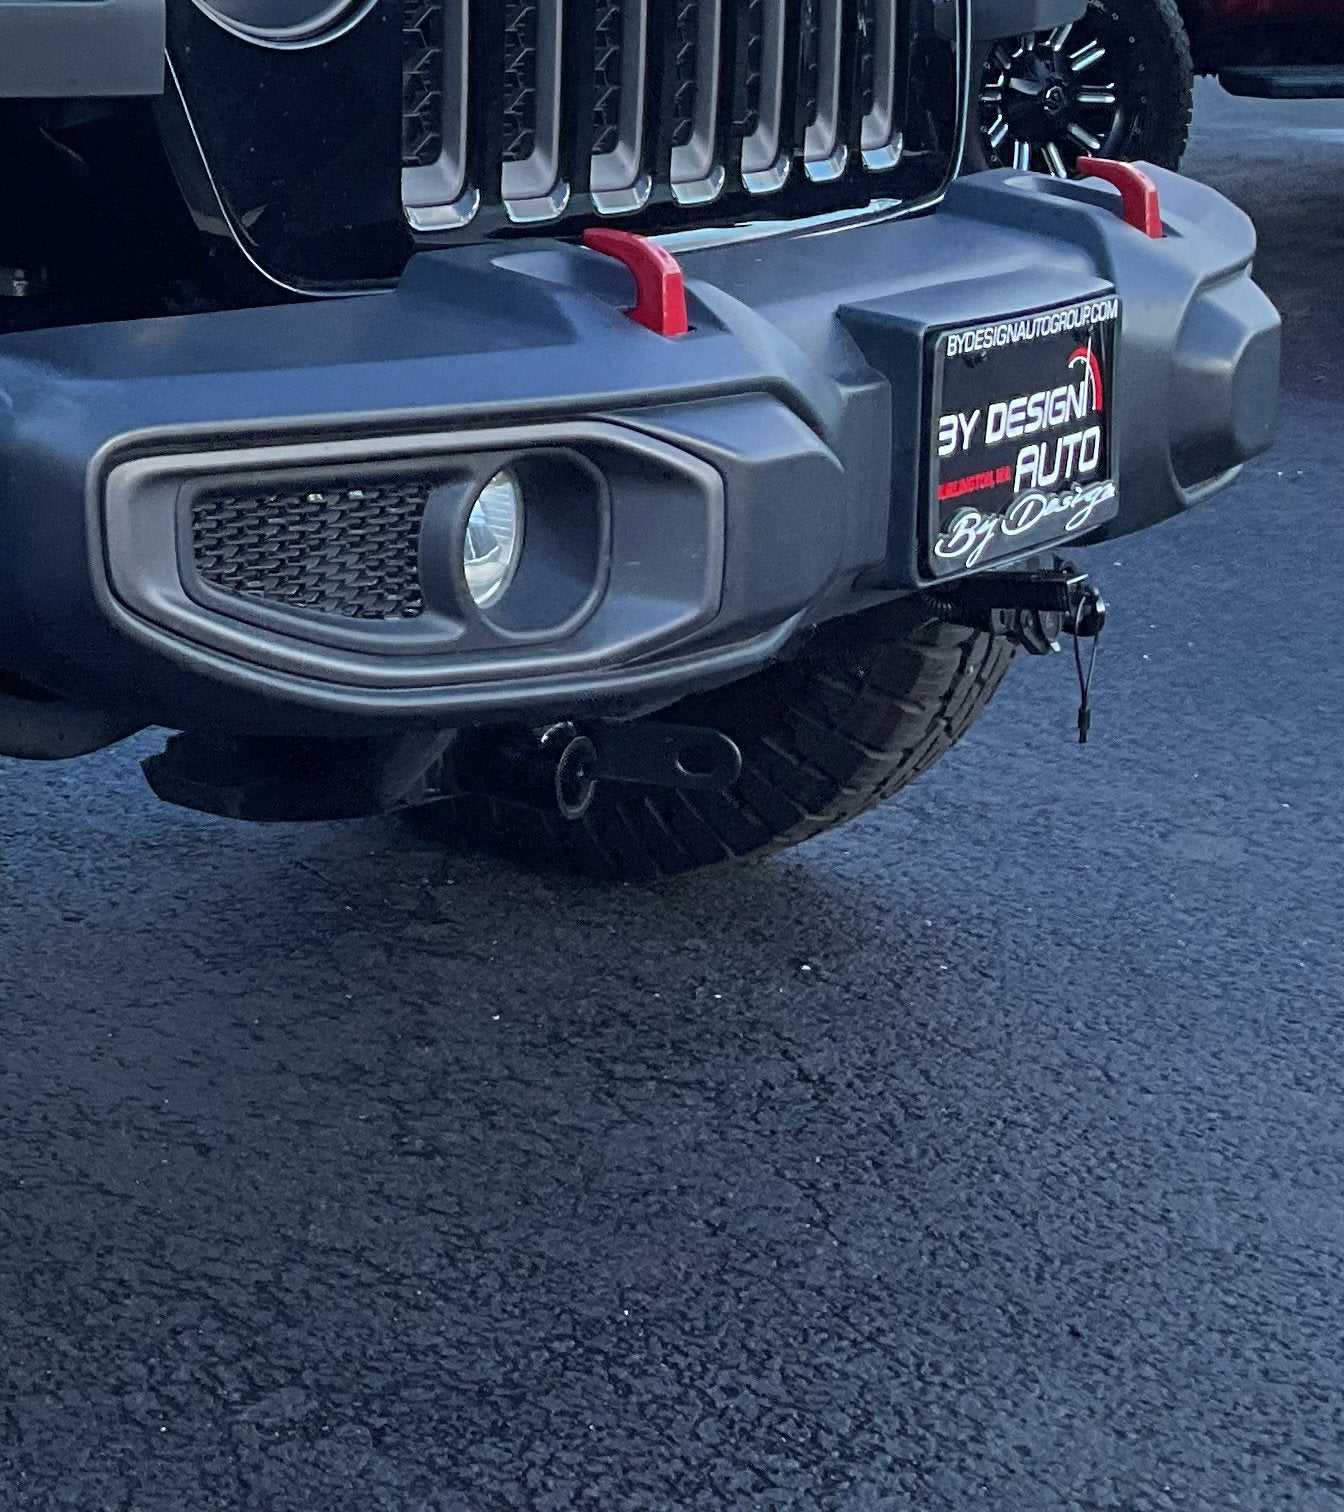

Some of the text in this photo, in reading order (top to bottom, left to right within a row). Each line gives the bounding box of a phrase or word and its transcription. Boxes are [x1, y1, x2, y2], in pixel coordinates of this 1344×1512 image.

[945, 298, 1119, 358] BYDESIGNAUTOGROUP.COM
[938, 380, 1088, 456] BY DESIGN
[1014, 425, 1101, 493] AUTO
